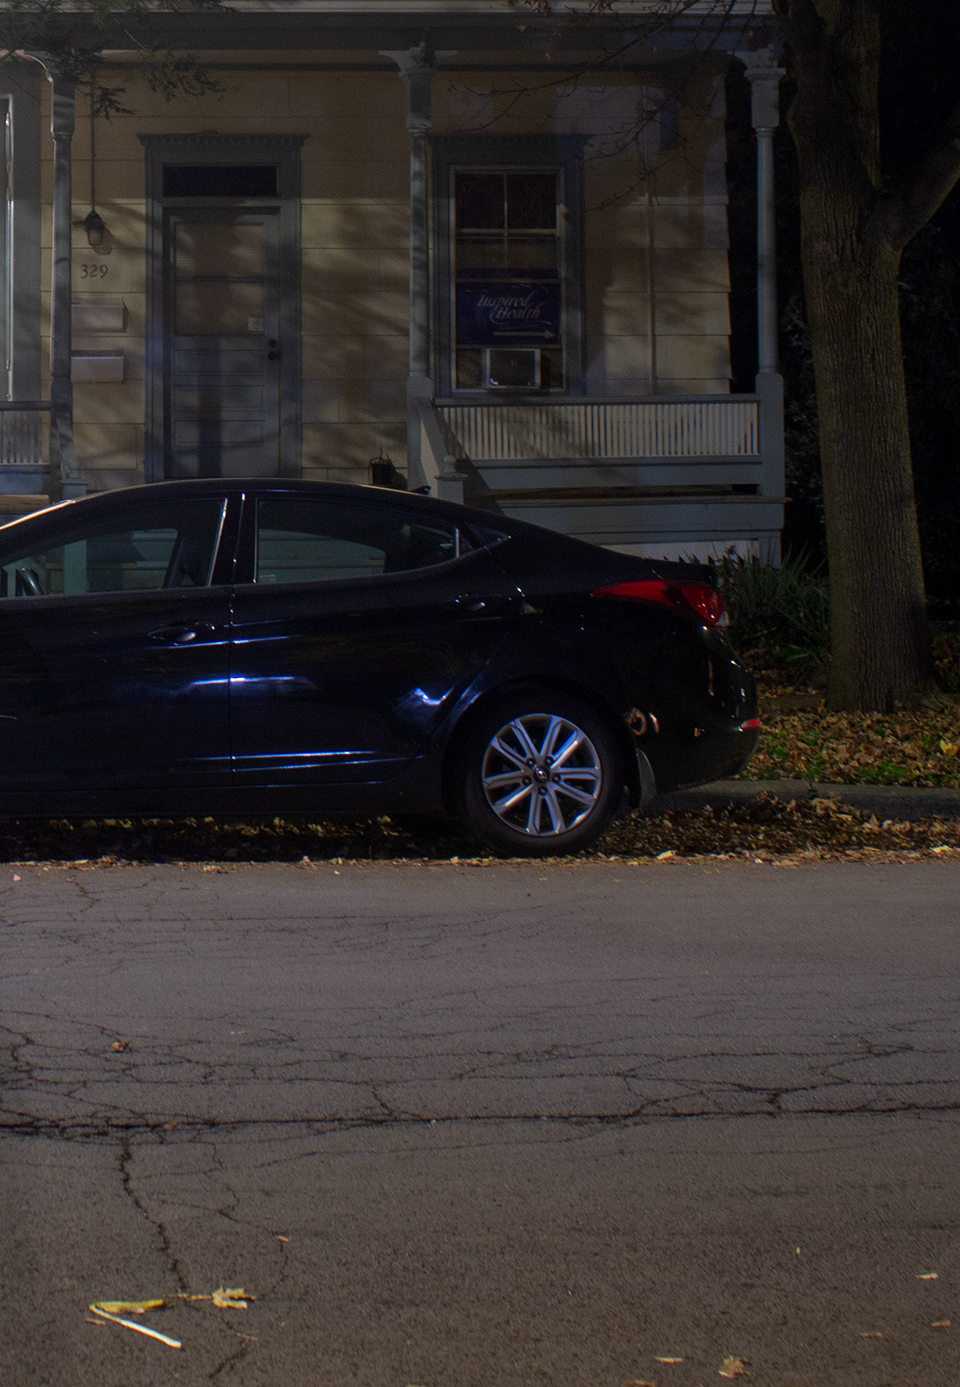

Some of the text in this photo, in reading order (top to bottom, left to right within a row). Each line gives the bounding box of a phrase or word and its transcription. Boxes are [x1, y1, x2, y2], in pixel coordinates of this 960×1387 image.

[80, 264, 109, 279] 329
[476, 291, 535, 309] Inspired
[495, 302, 543, 319] Health
